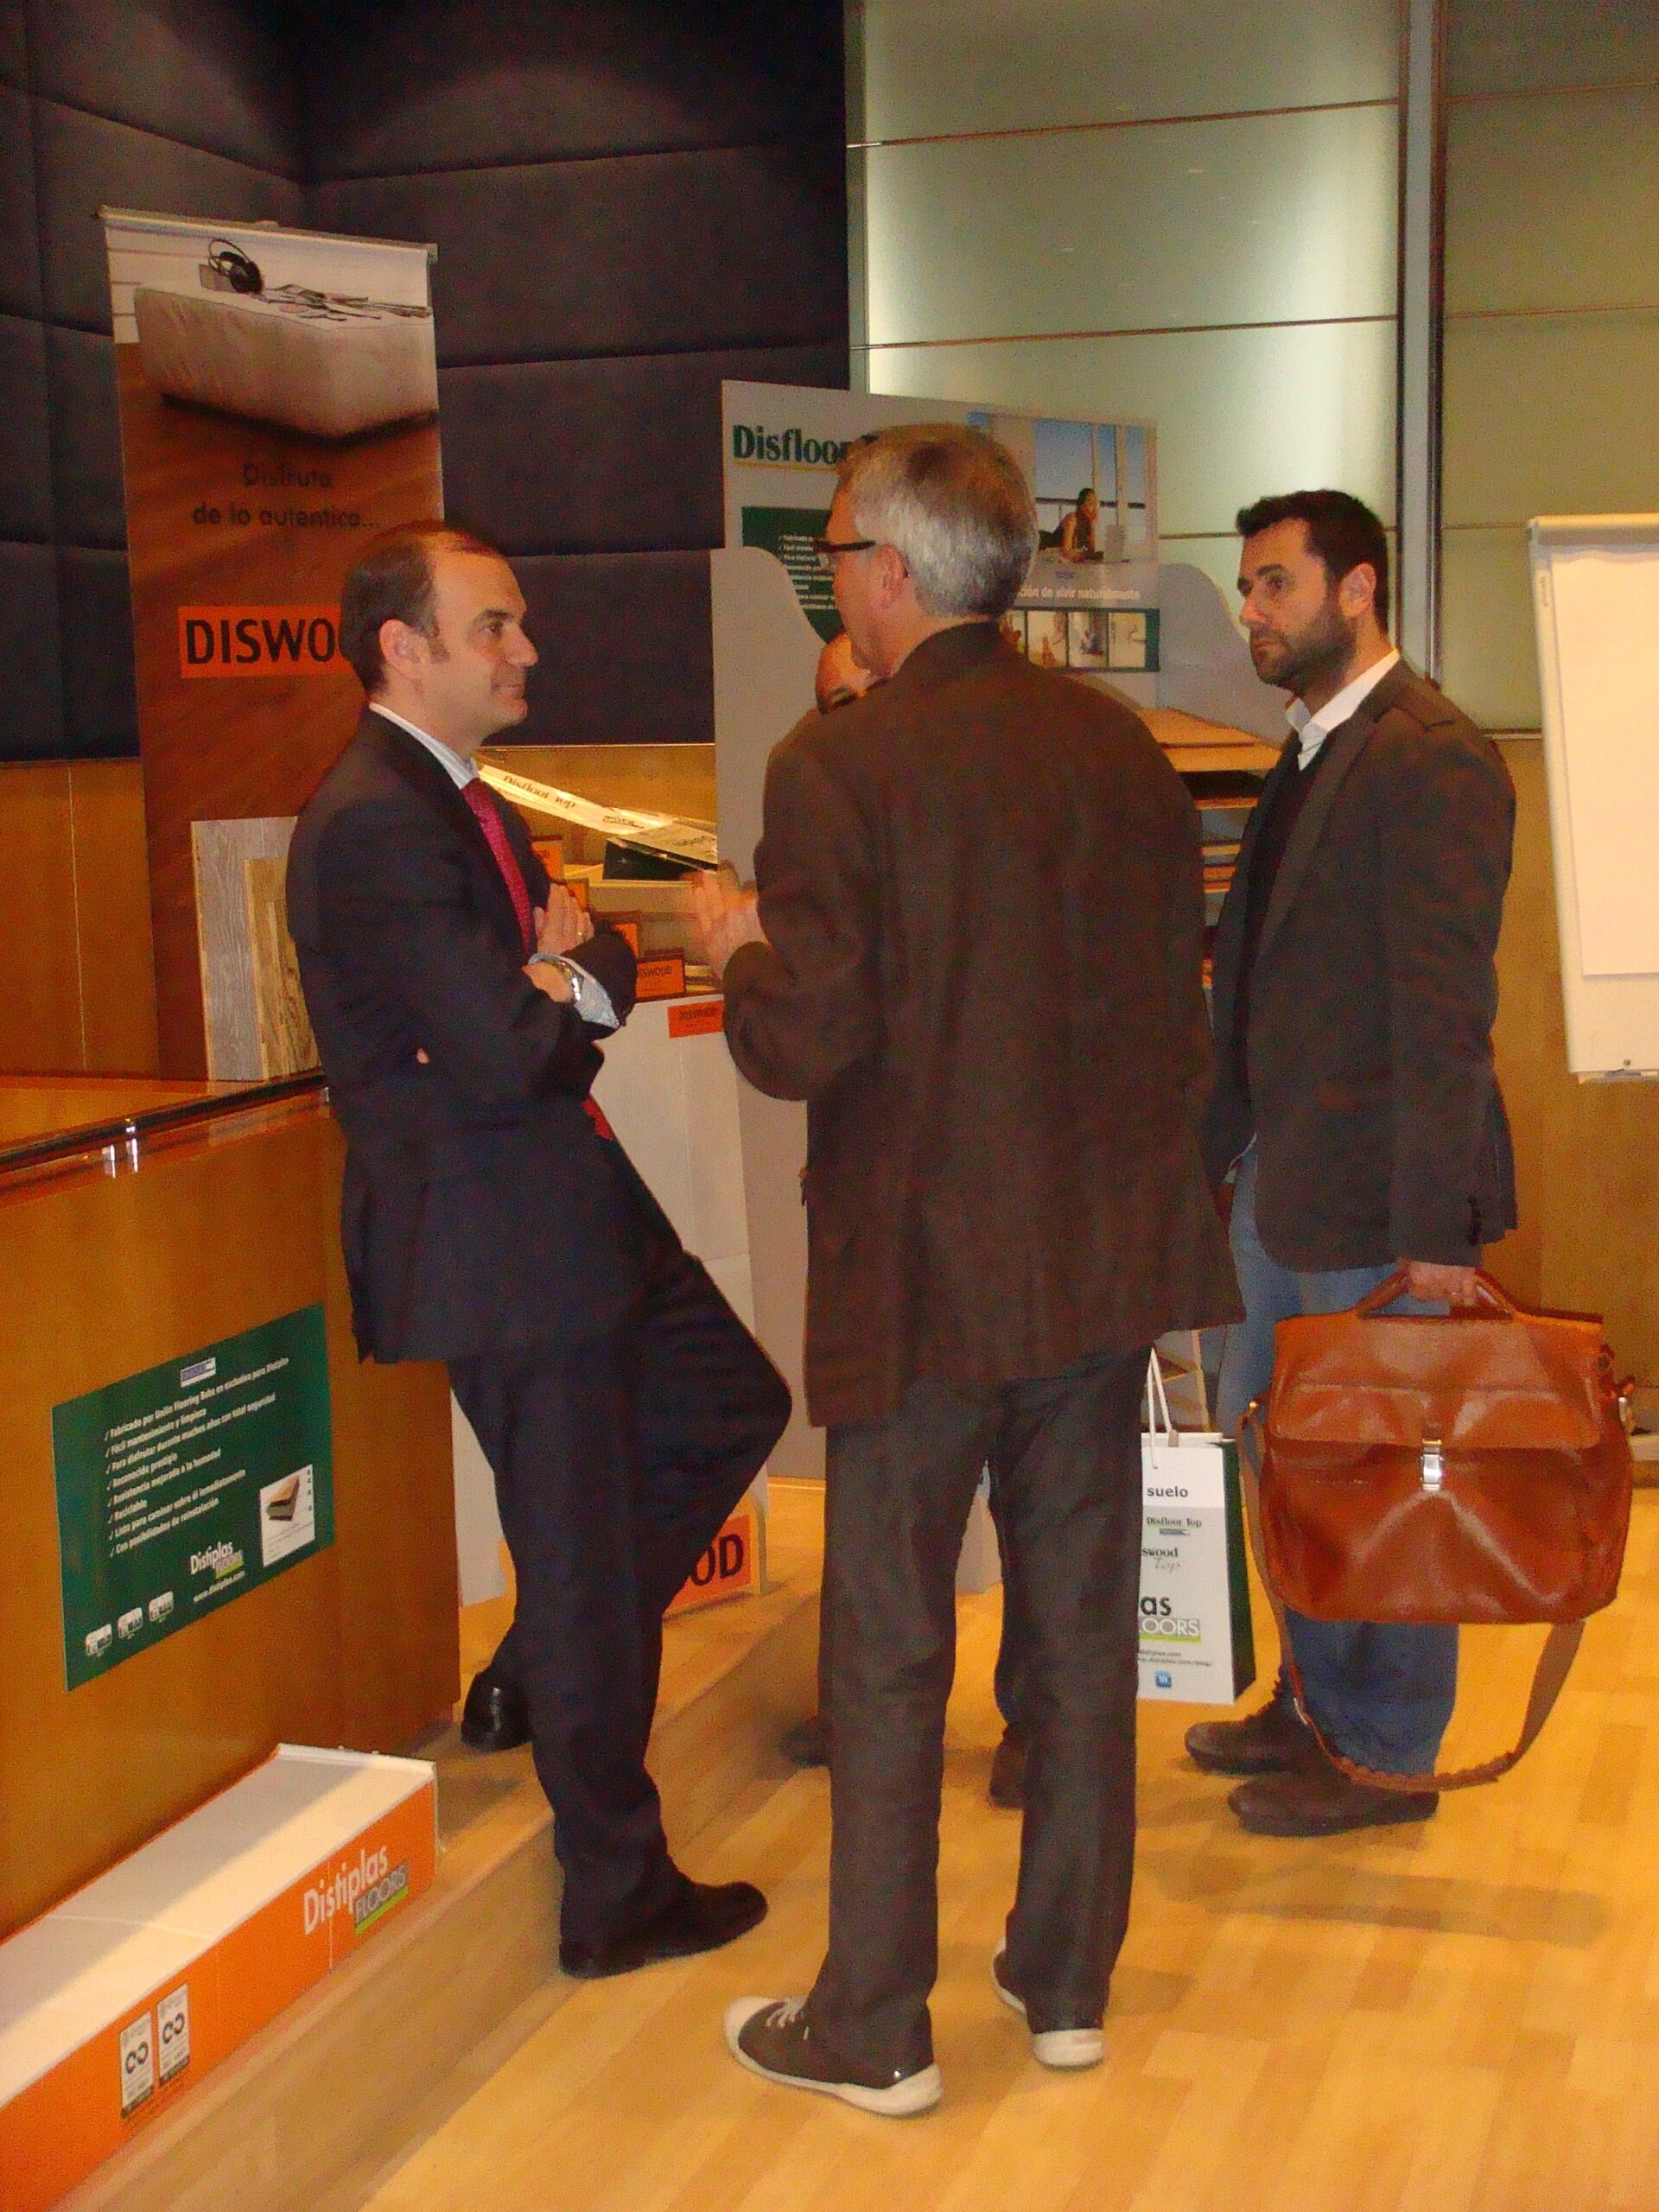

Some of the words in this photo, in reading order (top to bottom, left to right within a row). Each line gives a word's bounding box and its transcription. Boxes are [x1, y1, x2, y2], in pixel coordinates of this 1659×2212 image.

[192, 500, 221, 525] de
[186, 618, 336, 664] DISWO
[1147, 1486, 1188, 1497] suelo
[1147, 1516, 1181, 1526] Disfloor
[190, 1541, 233, 1575] Distiplas
[691, 1534, 744, 1586] OD
[1141, 1547, 1179, 1557] swood
[1140, 1595, 1172, 1616] as
[303, 1845, 389, 1936] Distiplas
